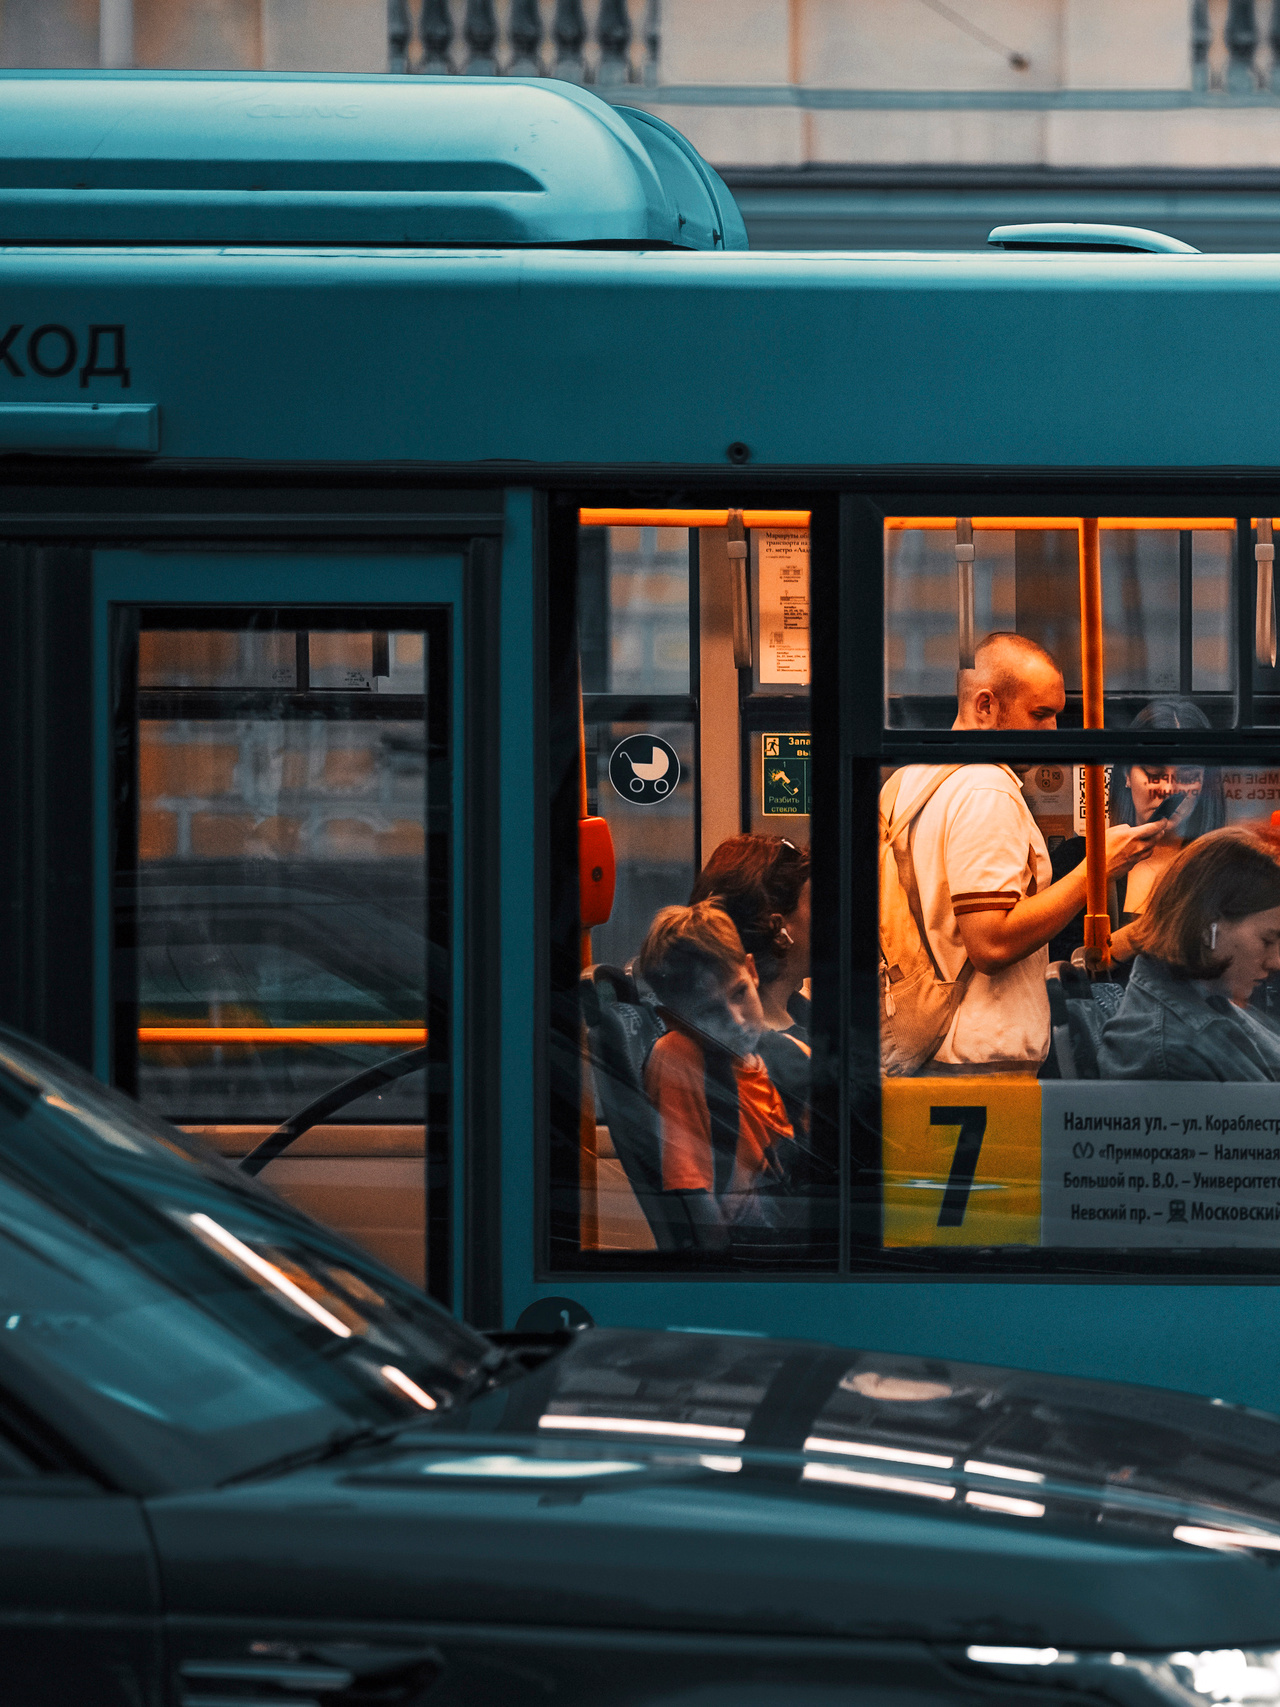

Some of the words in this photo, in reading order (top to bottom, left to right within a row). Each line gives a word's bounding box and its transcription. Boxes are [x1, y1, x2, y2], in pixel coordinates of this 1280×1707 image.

[1064, 1112, 1141, 1131] Наличная
[1144, 1116, 1168, 1136] ул.
[1182, 1116, 1202, 1135] ул.
[1098, 1143, 1196, 1164] «Приморская»
[1214, 1144, 1280, 1160] Наличная
[930, 1105, 987, 1227] 7
[1064, 1172, 1125, 1189] Большой
[1128, 1176, 1149, 1193] пр.
[1071, 1203, 1127, 1221] Невский
[1130, 1207, 1151, 1224] пр.
